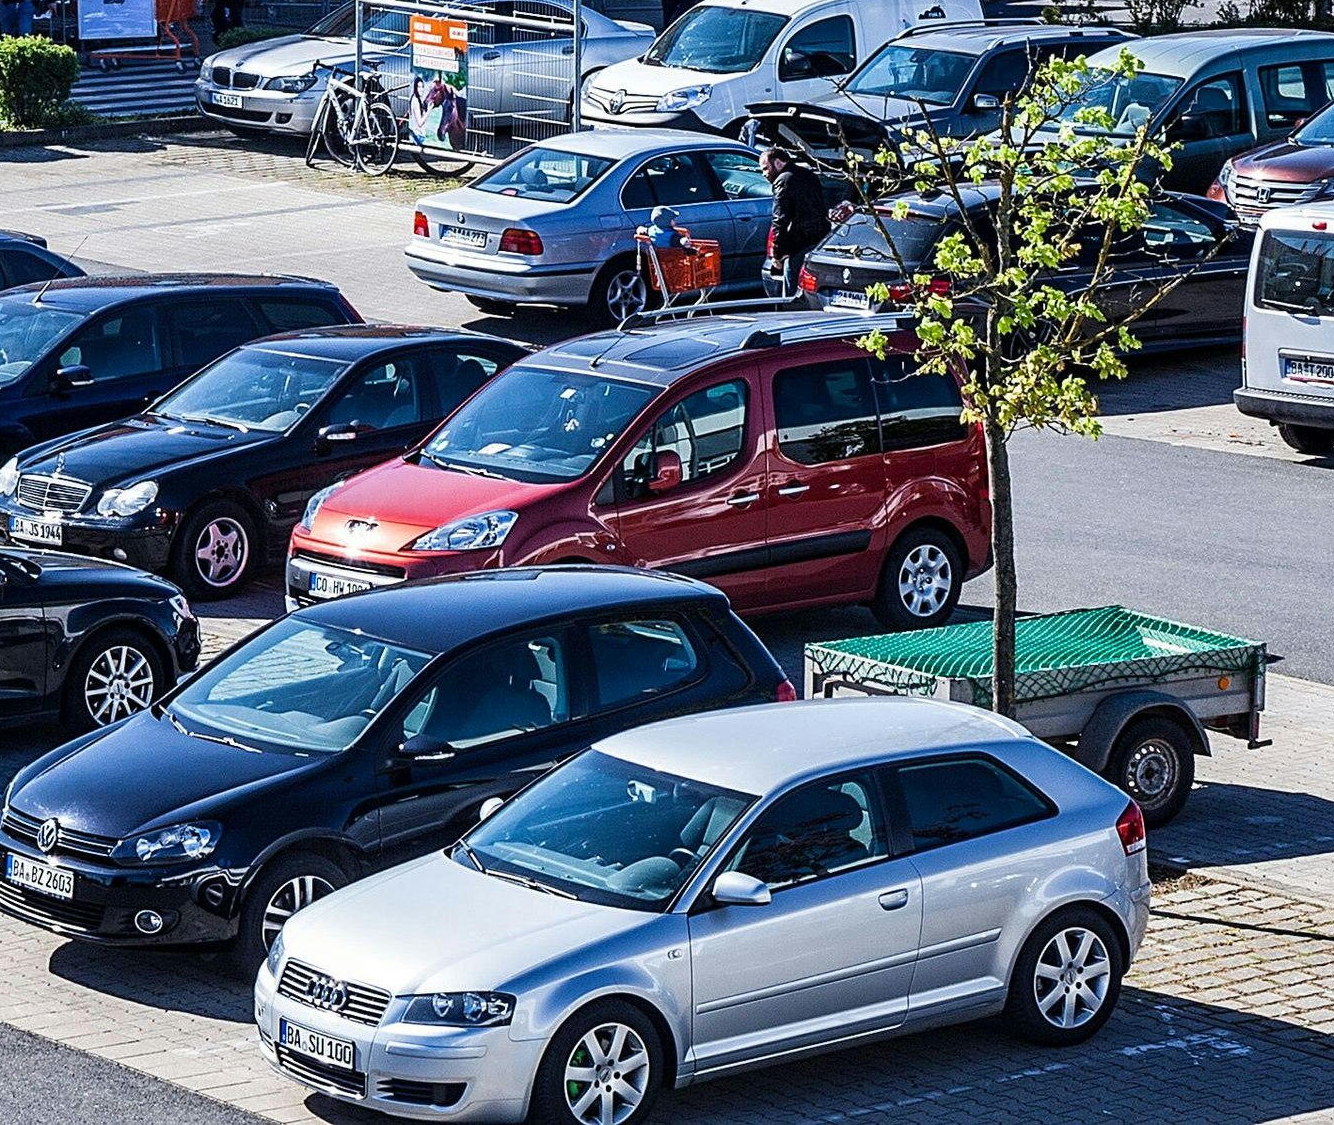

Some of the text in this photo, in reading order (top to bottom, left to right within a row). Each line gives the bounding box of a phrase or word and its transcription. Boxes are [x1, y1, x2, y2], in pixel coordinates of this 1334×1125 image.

[1291, 361, 1303, 375] BA
[15, 520, 24, 534] BA
[40, 525, 61, 541] 1944
[316, 577, 328, 592] CO
[333, 580, 345, 594] HW
[13, 859, 25, 879] BA
[31, 865, 44, 886] BZ
[45, 870, 72, 894] 2603
[287, 1026, 352, 1065] BA SU 100
